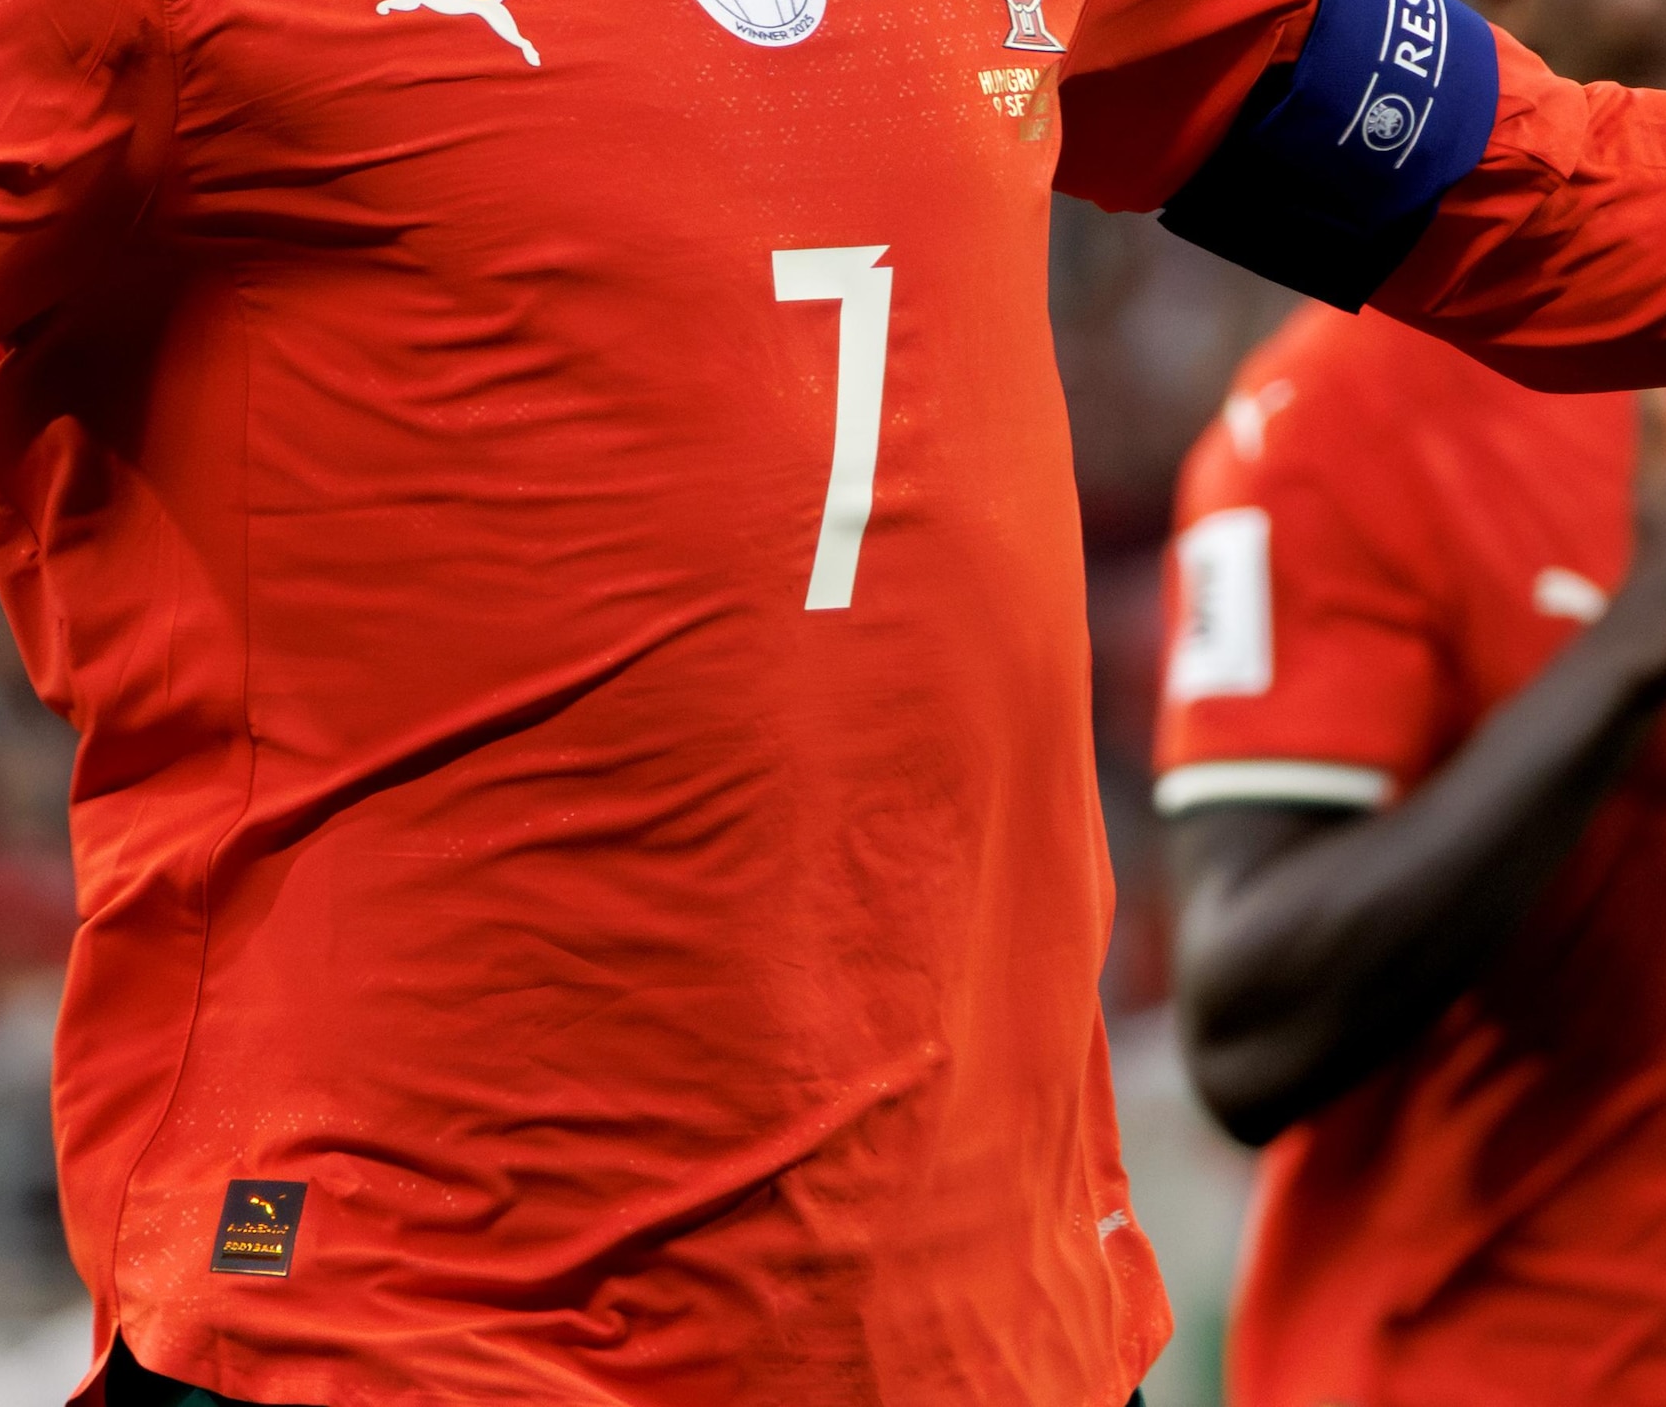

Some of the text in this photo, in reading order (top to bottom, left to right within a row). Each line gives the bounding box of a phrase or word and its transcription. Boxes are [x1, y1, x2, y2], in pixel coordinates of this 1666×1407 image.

[736, 13, 815, 41] WINNER 2025
[993, 96, 1002, 117] 9
[771, 244, 893, 610] 7
